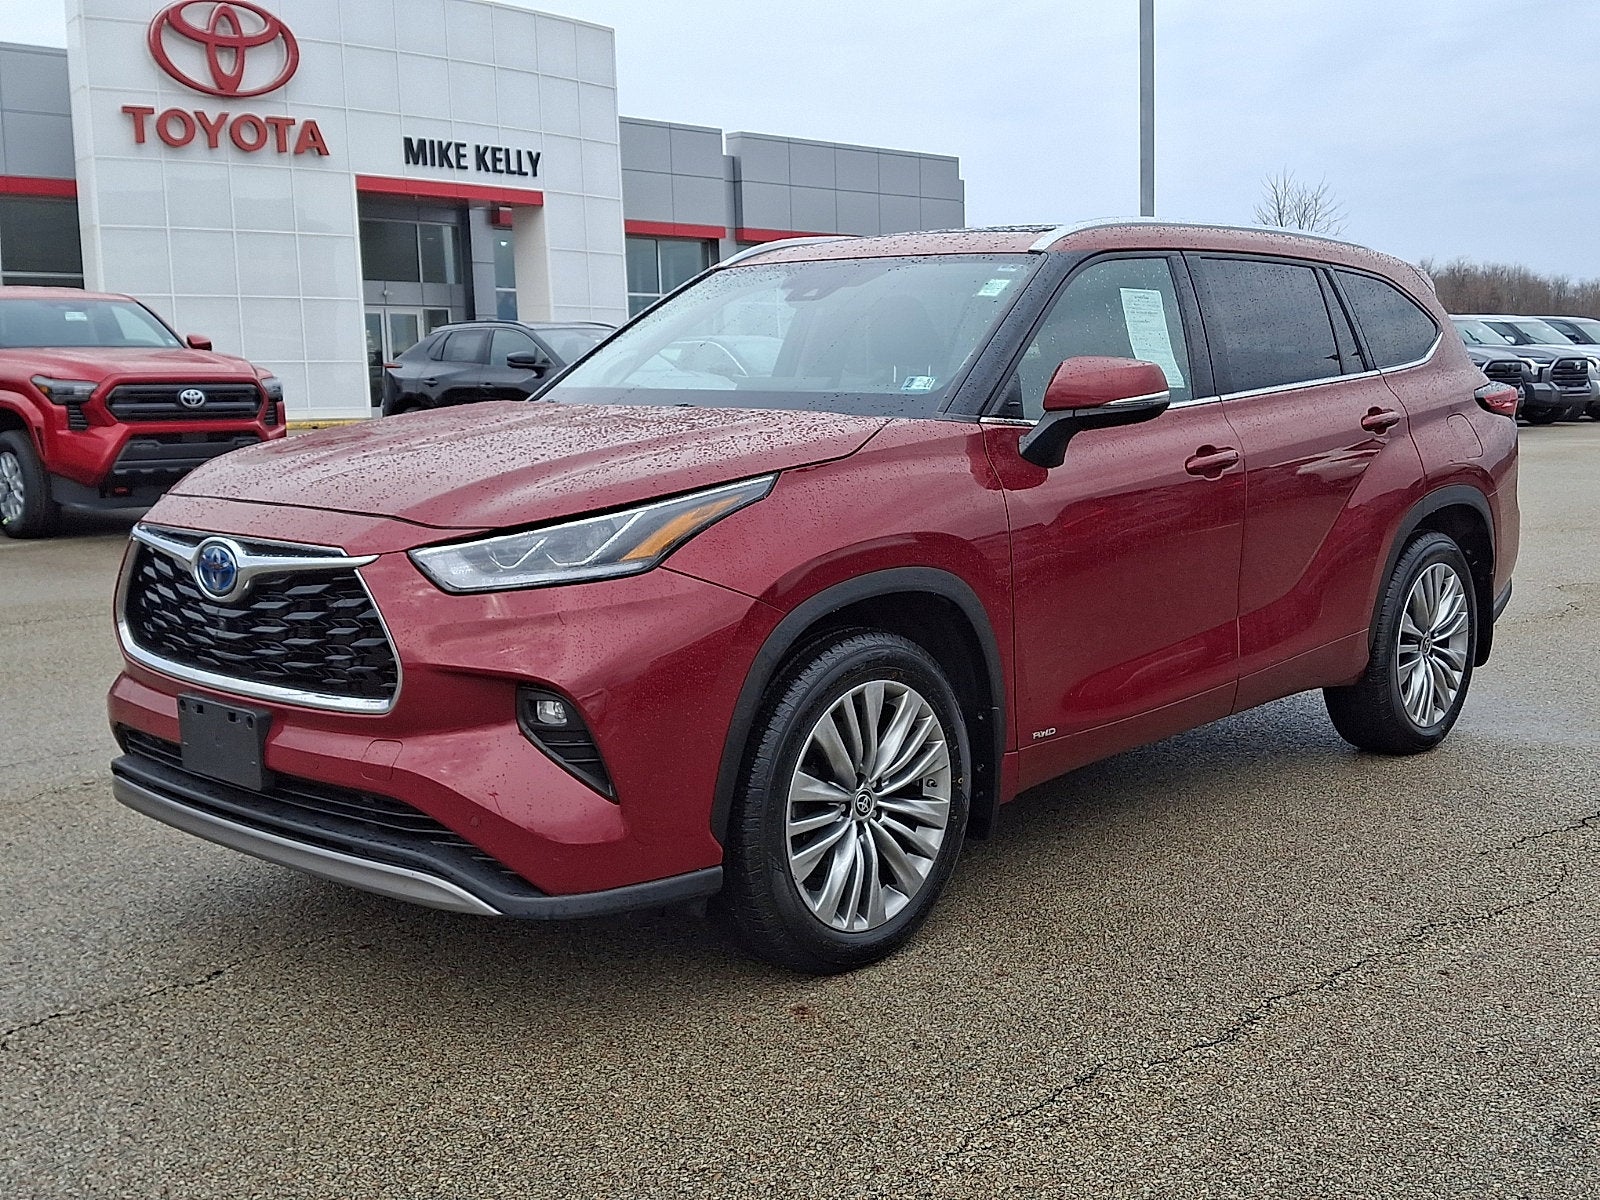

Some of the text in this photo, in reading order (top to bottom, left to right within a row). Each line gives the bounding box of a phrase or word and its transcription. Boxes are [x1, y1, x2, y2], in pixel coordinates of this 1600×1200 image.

[122, 106, 330, 156] TOYOTA
[403, 136, 541, 177] MIKE KELLY
[1032, 727, 1056, 740] AWD
